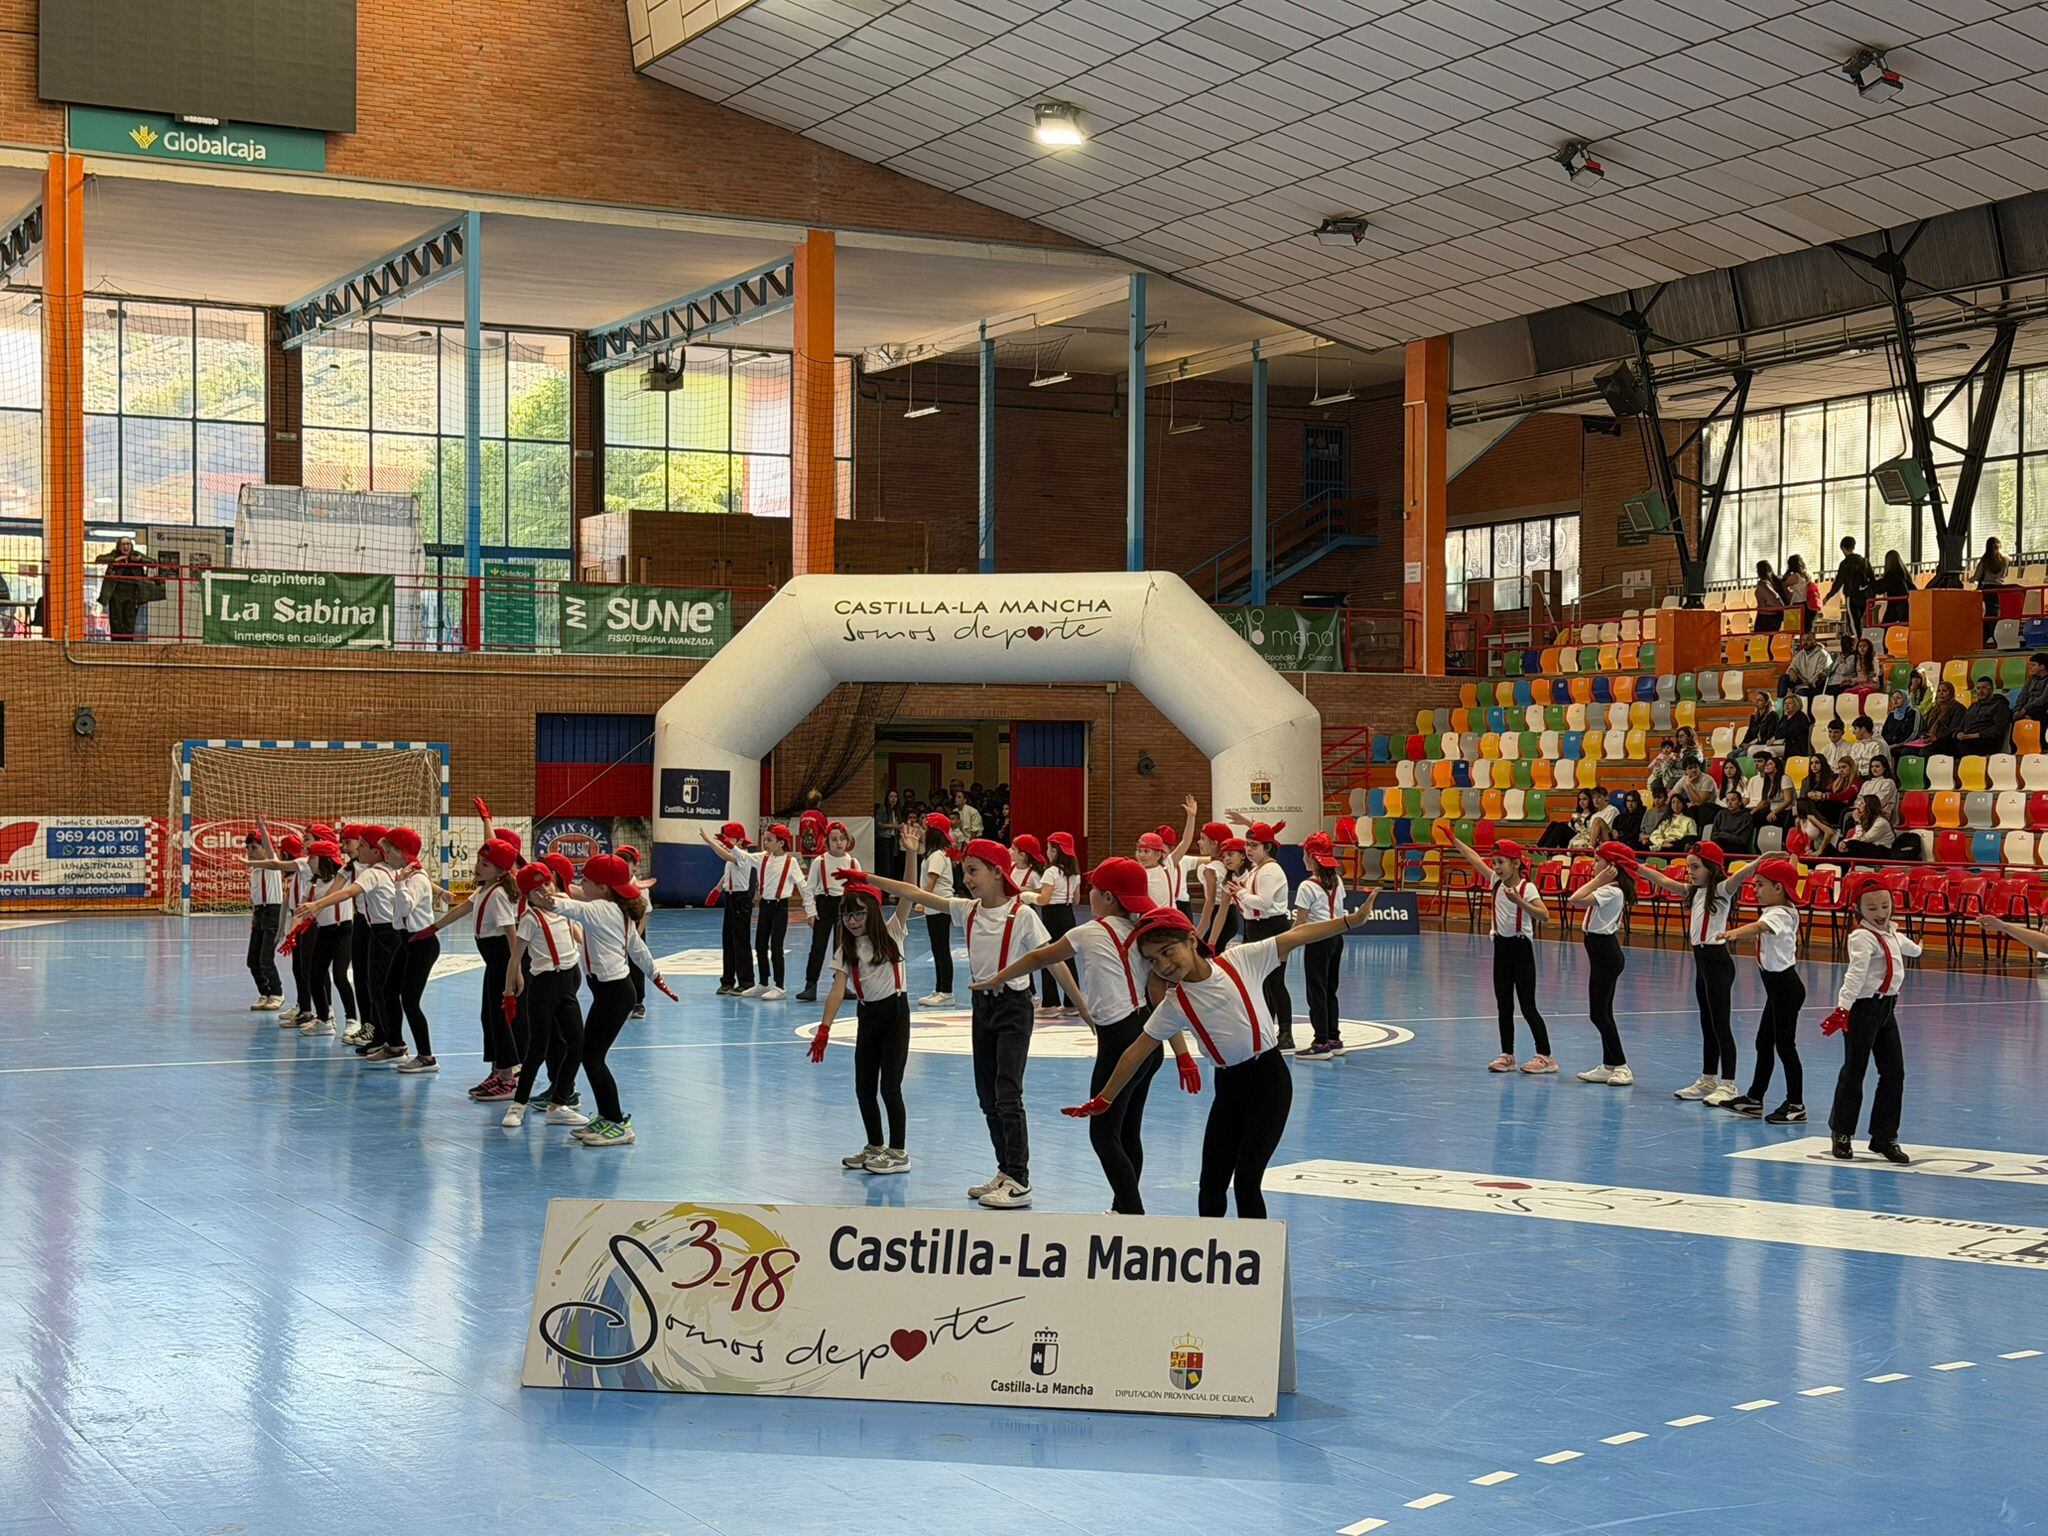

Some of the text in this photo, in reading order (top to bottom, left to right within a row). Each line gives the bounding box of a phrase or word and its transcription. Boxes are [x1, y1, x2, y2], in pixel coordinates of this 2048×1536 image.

[163, 131, 266, 161] Globalcaja
[219, 594, 376, 625] La Sabina
[834, 598, 1112, 615] CASTILLA-LA MANCHA
[842, 617, 936, 642] Somos
[287, 633, 301, 643] en
[303, 632, 343, 644] calidad
[607, 634, 715, 647] FISIOTERAPIA AVANZADA
[1271, 629, 1335, 648] mena
[664, 805, 722, 816] Castilla-La Mancha
[56, 830, 139, 843] 969 408 101
[76, 845, 140, 855] 722 410 356
[61, 861, 134, 870] LUNAS TINTADAS
[63, 871, 132, 880] HOMOLOGADAS
[13, 887, 27, 896] en
[29, 885, 56, 896] lunas
[57, 886, 74, 895] del
[75, 883, 127, 895] automóvil
[1354, 906, 1409, 921] ancha
[1870, 1214, 2027, 1235] Mancha
[829, 1225, 1261, 1286] Castilla-La Mancha
[539, 1234, 764, 1366] Somos
[990, 1379, 1094, 1396] Castilla-La Mancha
[1115, 1388, 1255, 1404] DIPUTACIÓN PROVINCIAL DE CUENCA
